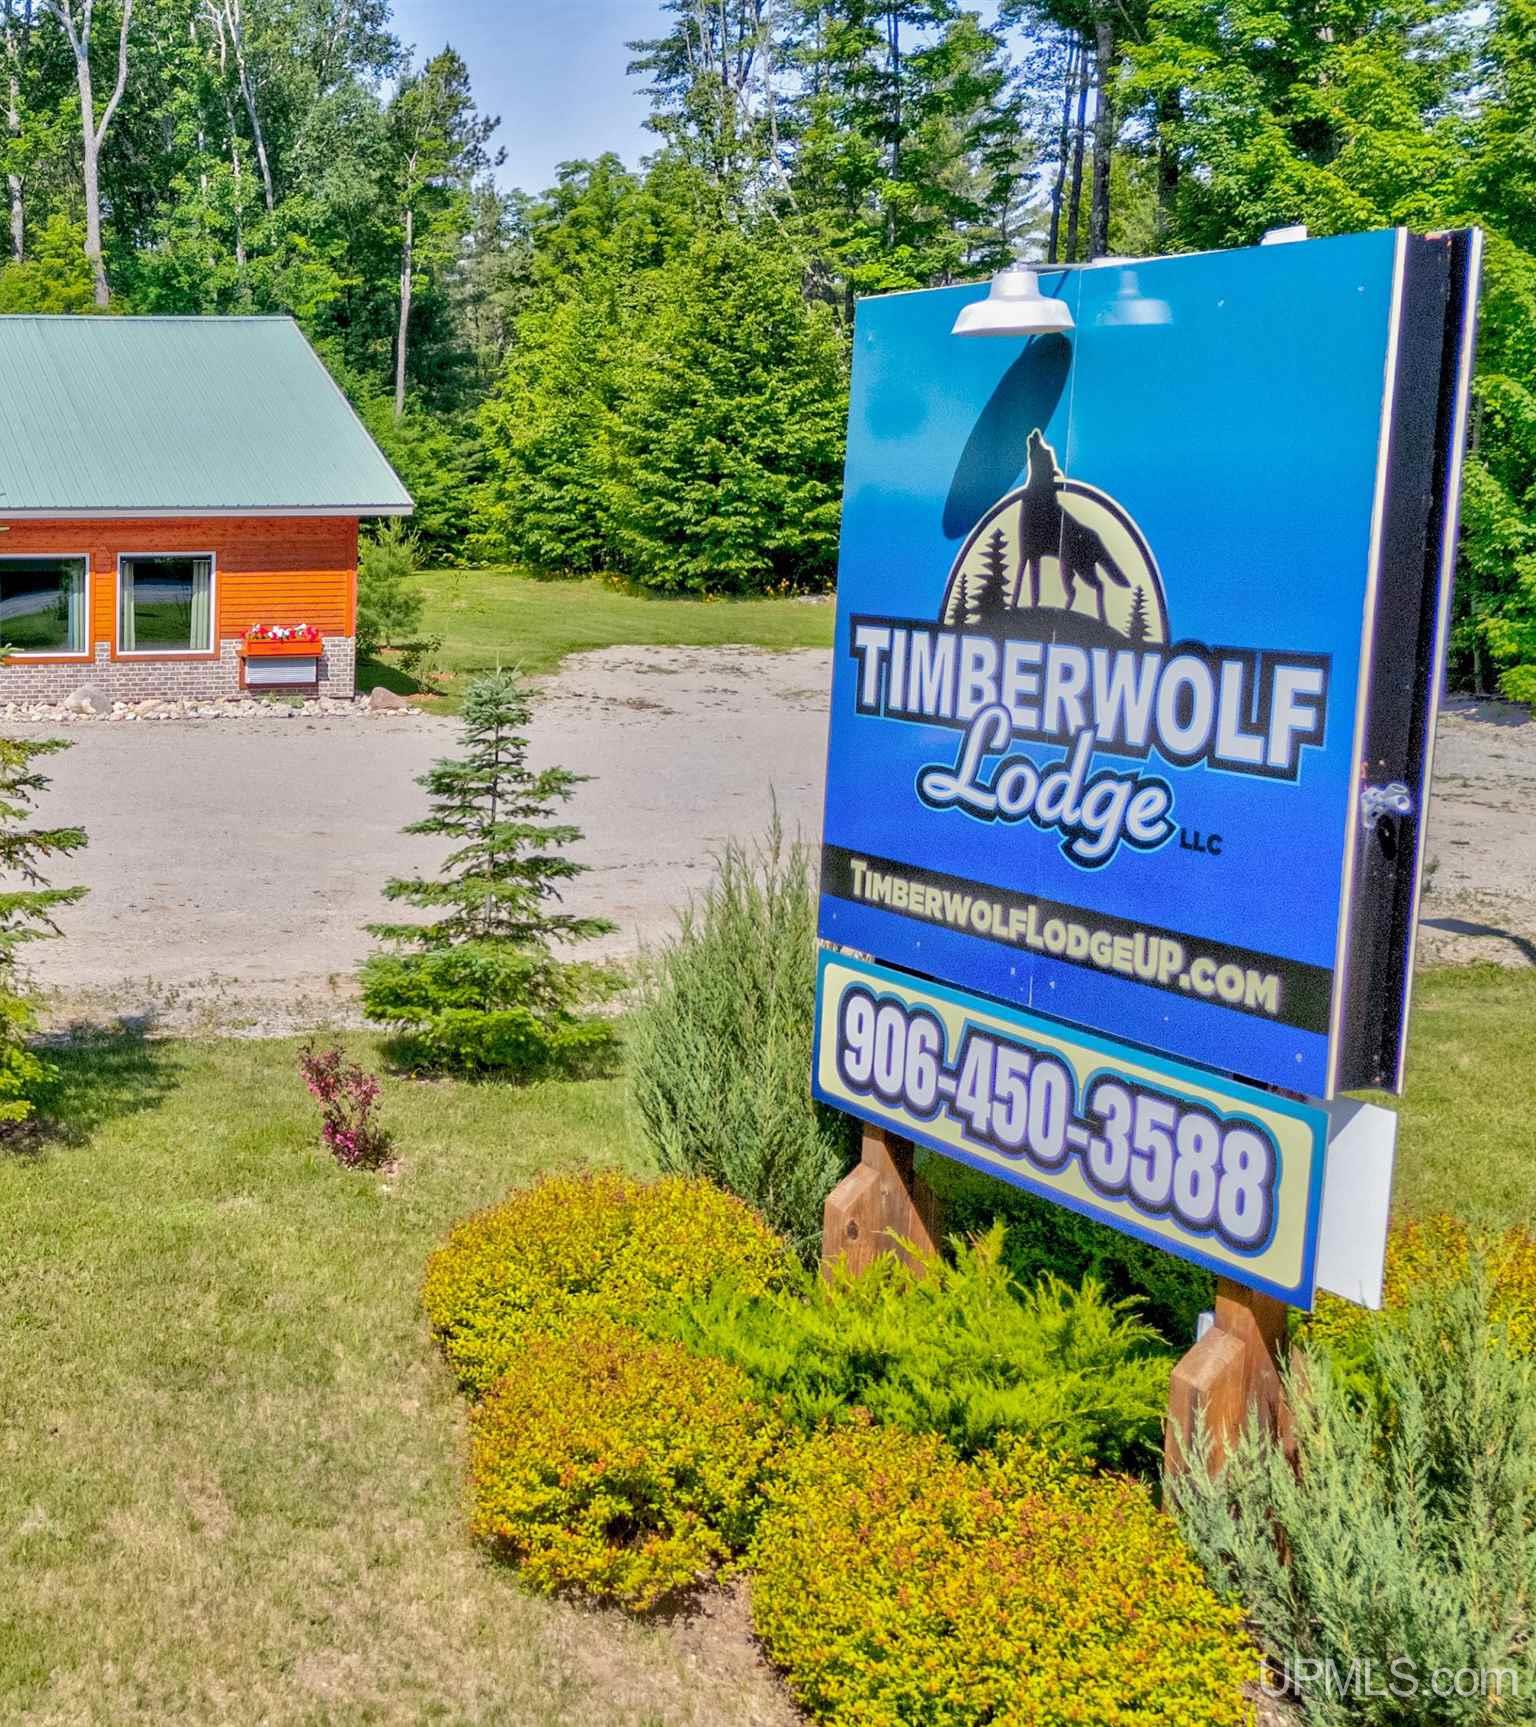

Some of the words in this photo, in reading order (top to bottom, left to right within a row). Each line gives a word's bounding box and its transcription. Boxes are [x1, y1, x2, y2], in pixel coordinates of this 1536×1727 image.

[855, 627, 1325, 767] TIMBERWOLF
[922, 708, 1170, 857] Lodge
[1179, 830, 1224, 856] LLC
[844, 996, 1269, 1240] 906-450-3588
